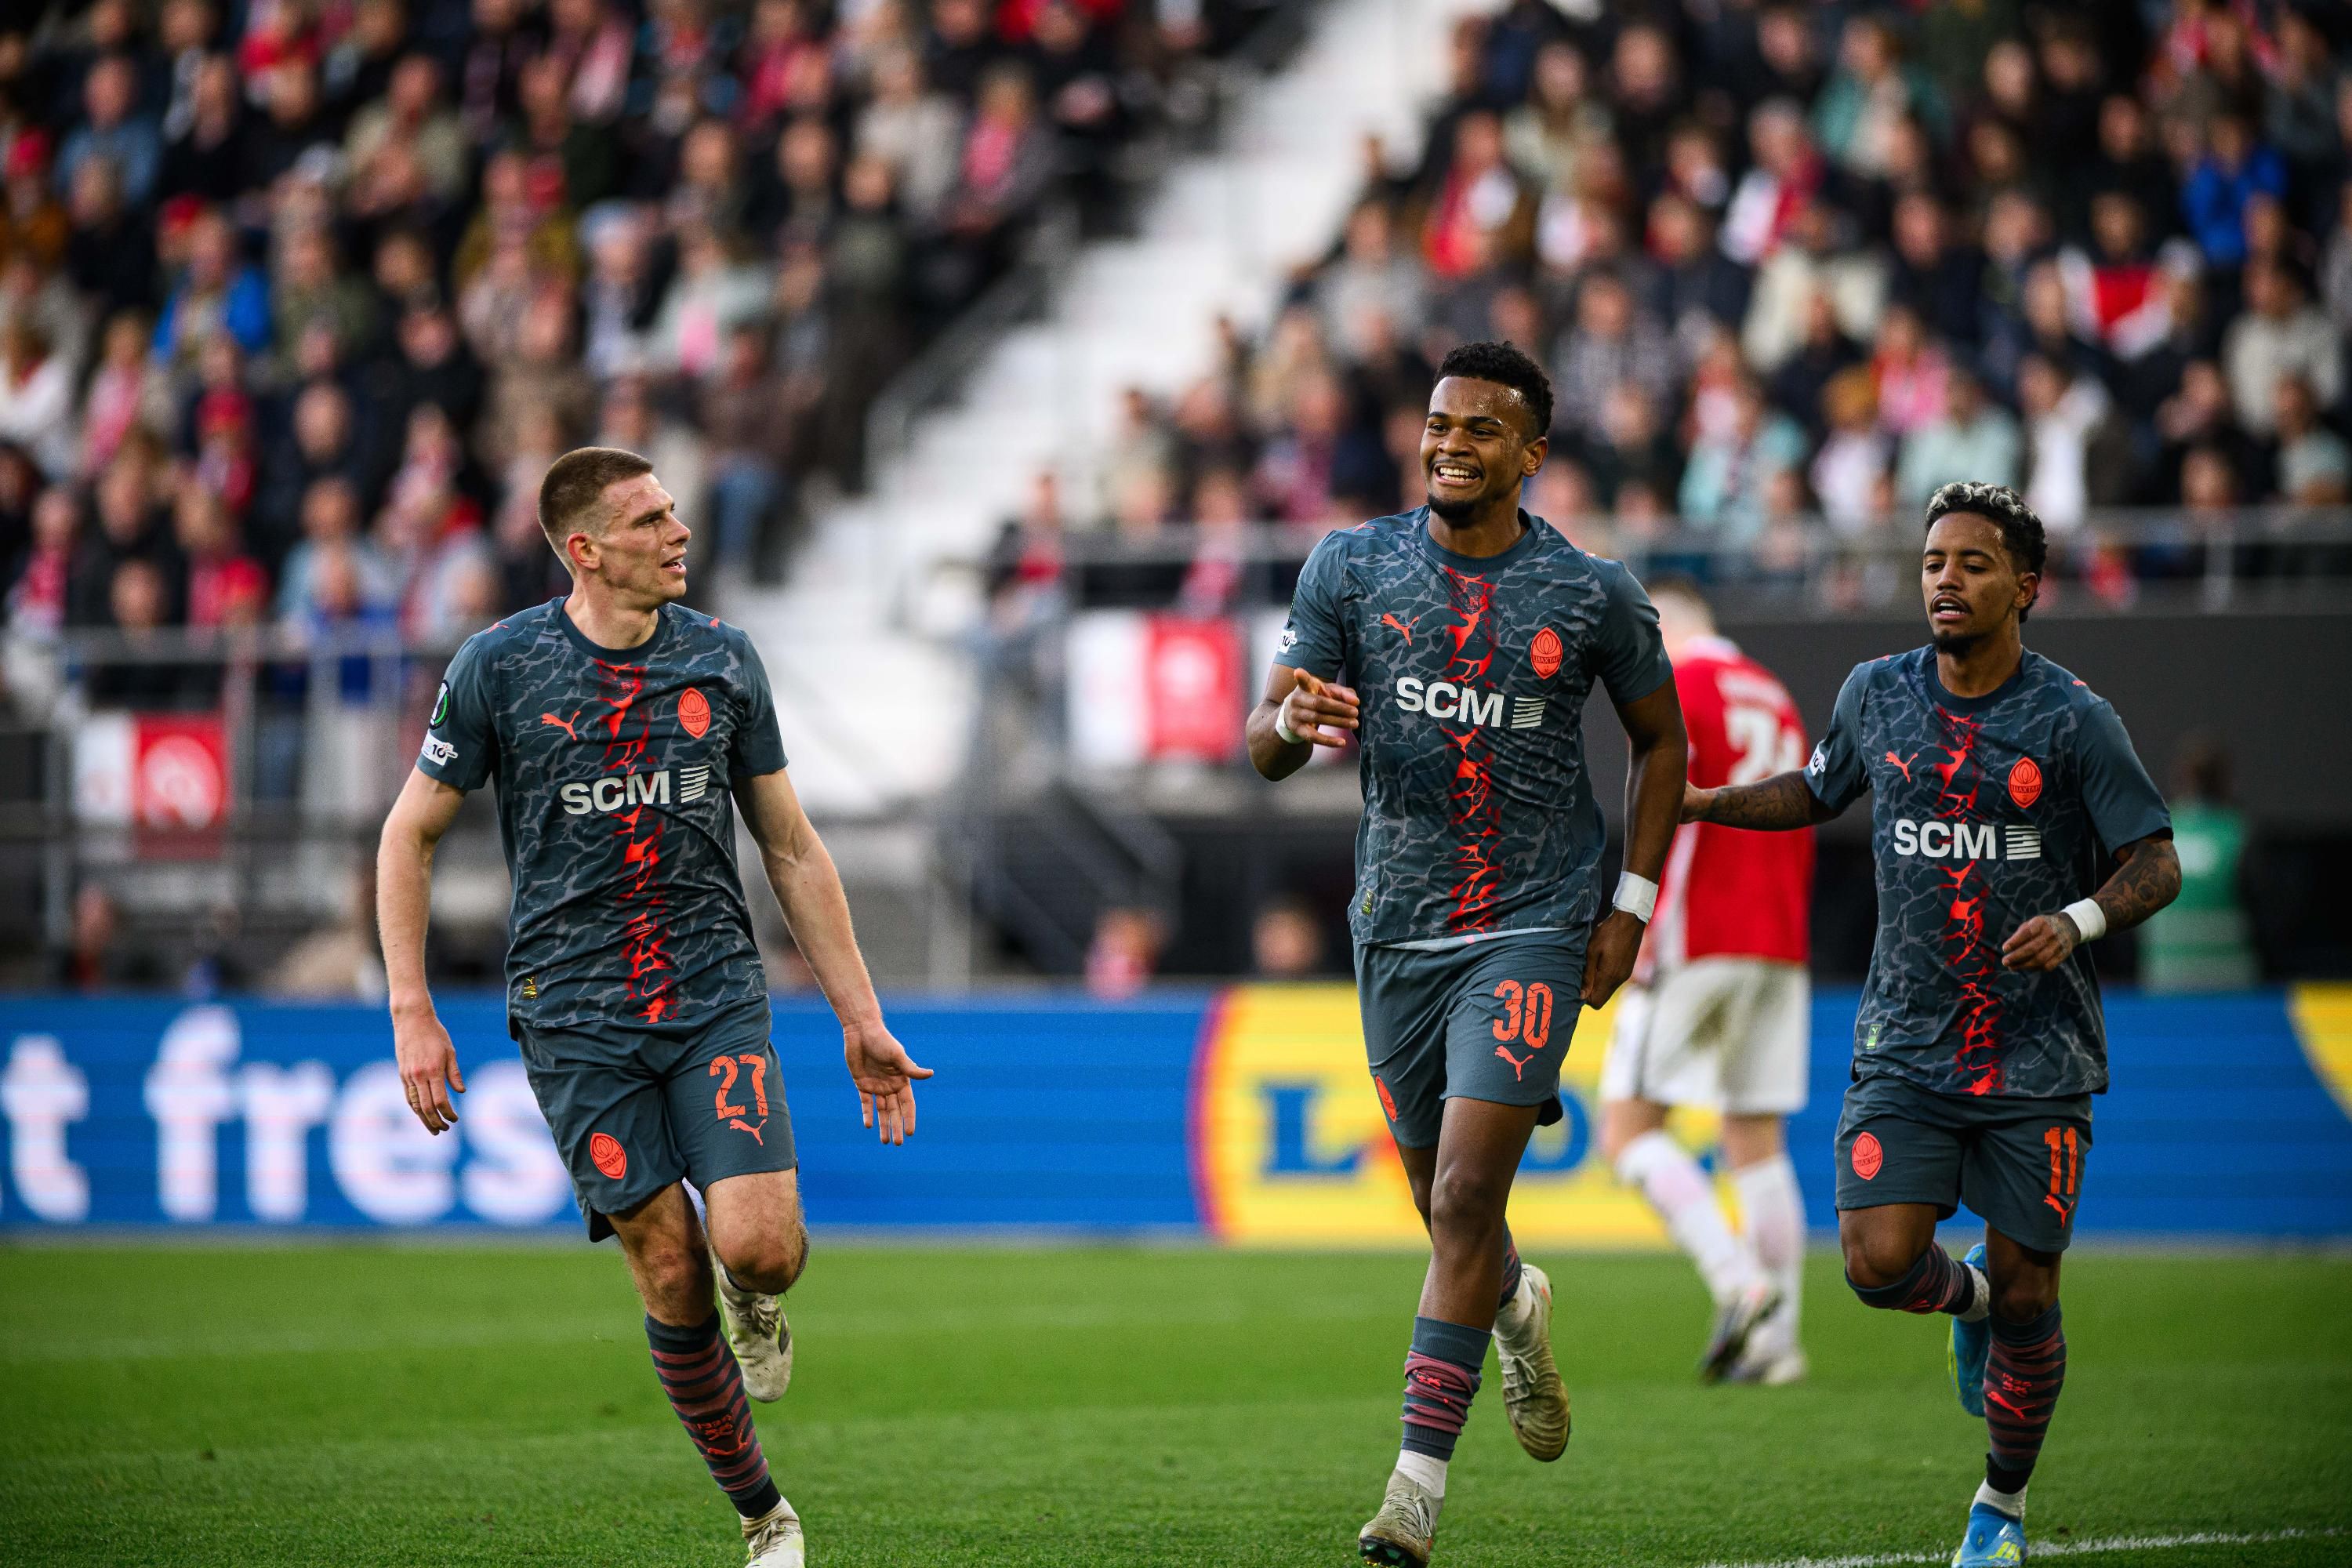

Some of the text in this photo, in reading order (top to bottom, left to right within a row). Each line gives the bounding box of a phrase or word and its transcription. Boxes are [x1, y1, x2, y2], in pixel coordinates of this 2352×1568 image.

[1396, 677, 1504, 728] SCM
[560, 770, 670, 815] SCM
[1893, 818, 1997, 859] SCM
[1492, 979, 1553, 1049] 30
[0, 1004, 708, 1225] t fres
[709, 1054, 768, 1120] 27
[2044, 1127, 2078, 1195] 11
